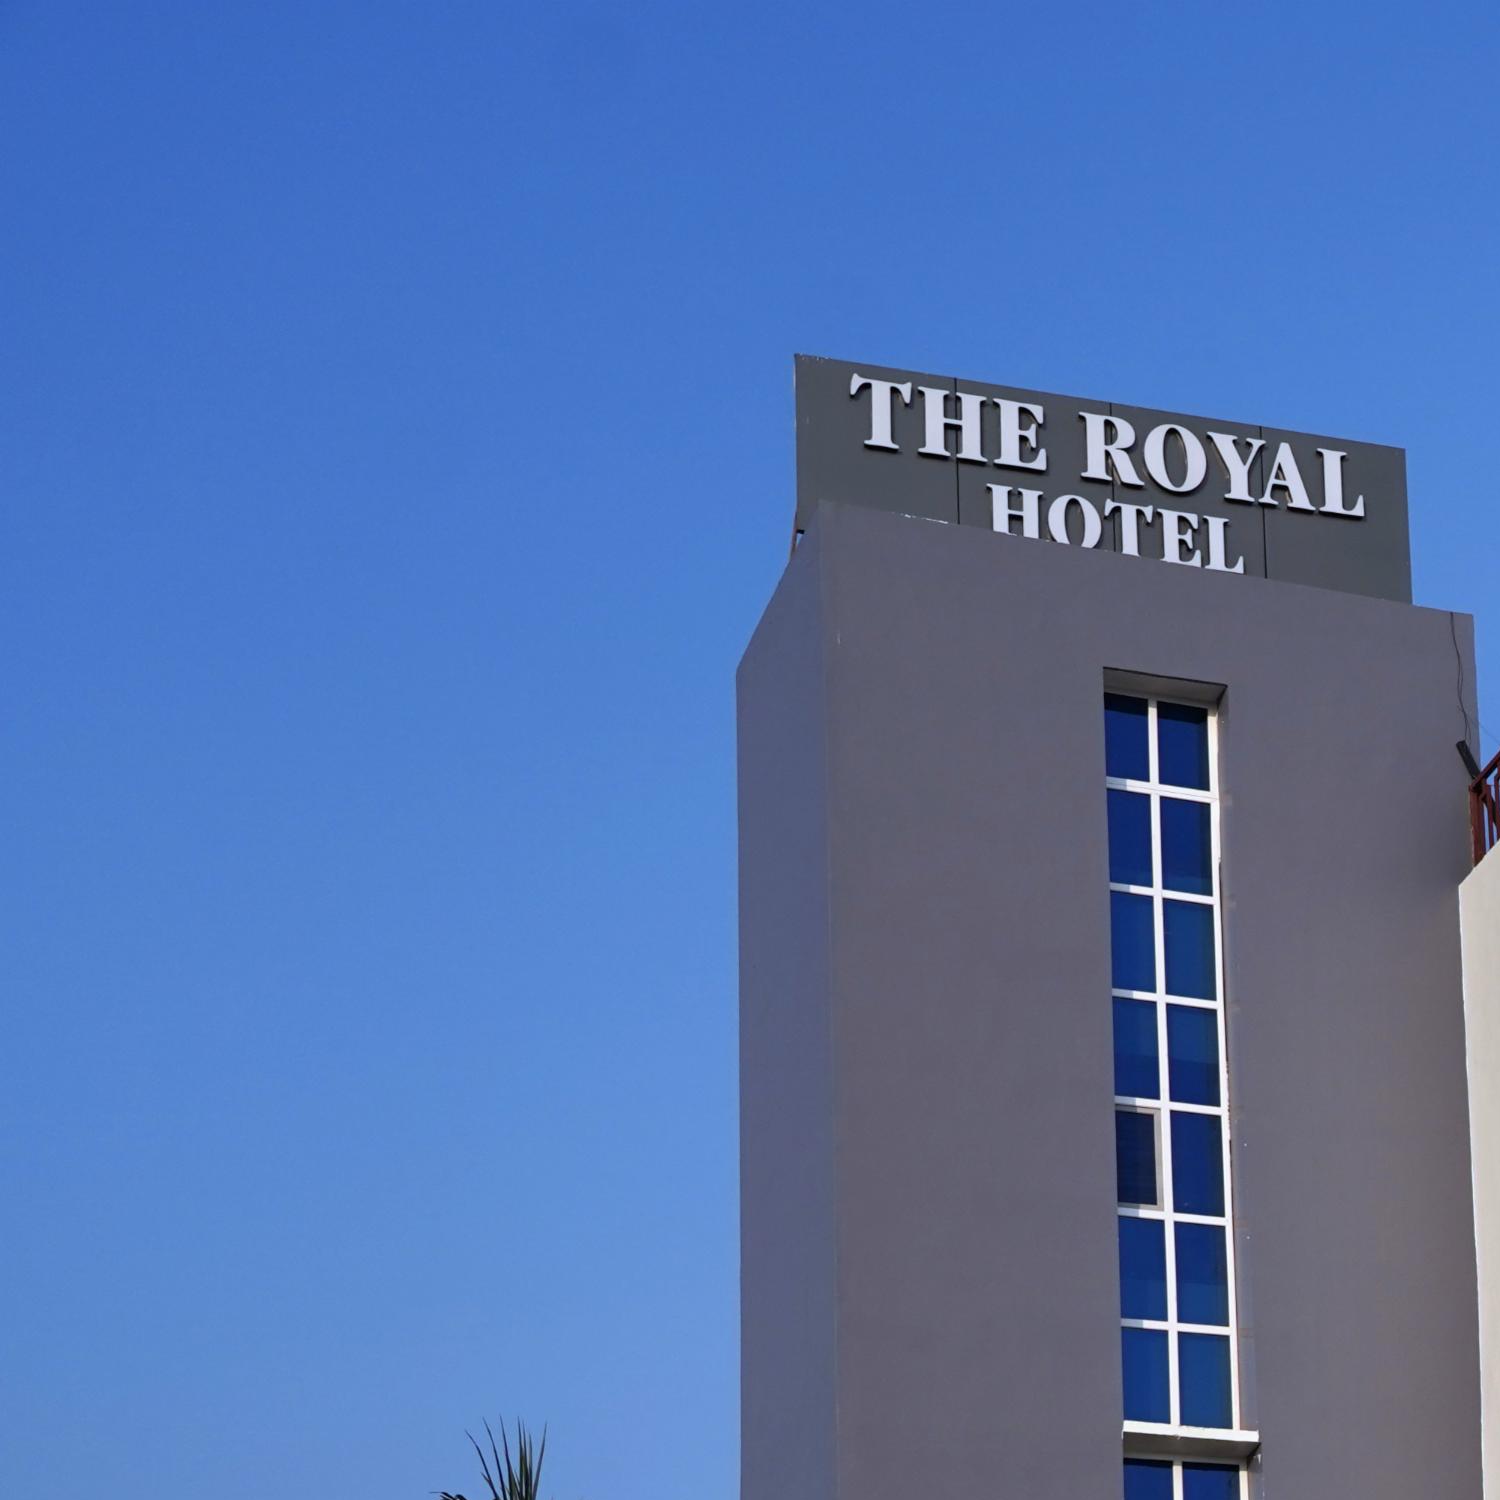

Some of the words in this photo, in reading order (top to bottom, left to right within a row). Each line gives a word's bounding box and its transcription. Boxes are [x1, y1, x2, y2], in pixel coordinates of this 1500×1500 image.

[849, 373, 1048, 471] THE
[1079, 412, 1365, 518] ROYAL
[986, 483, 1245, 574] HOTEL
